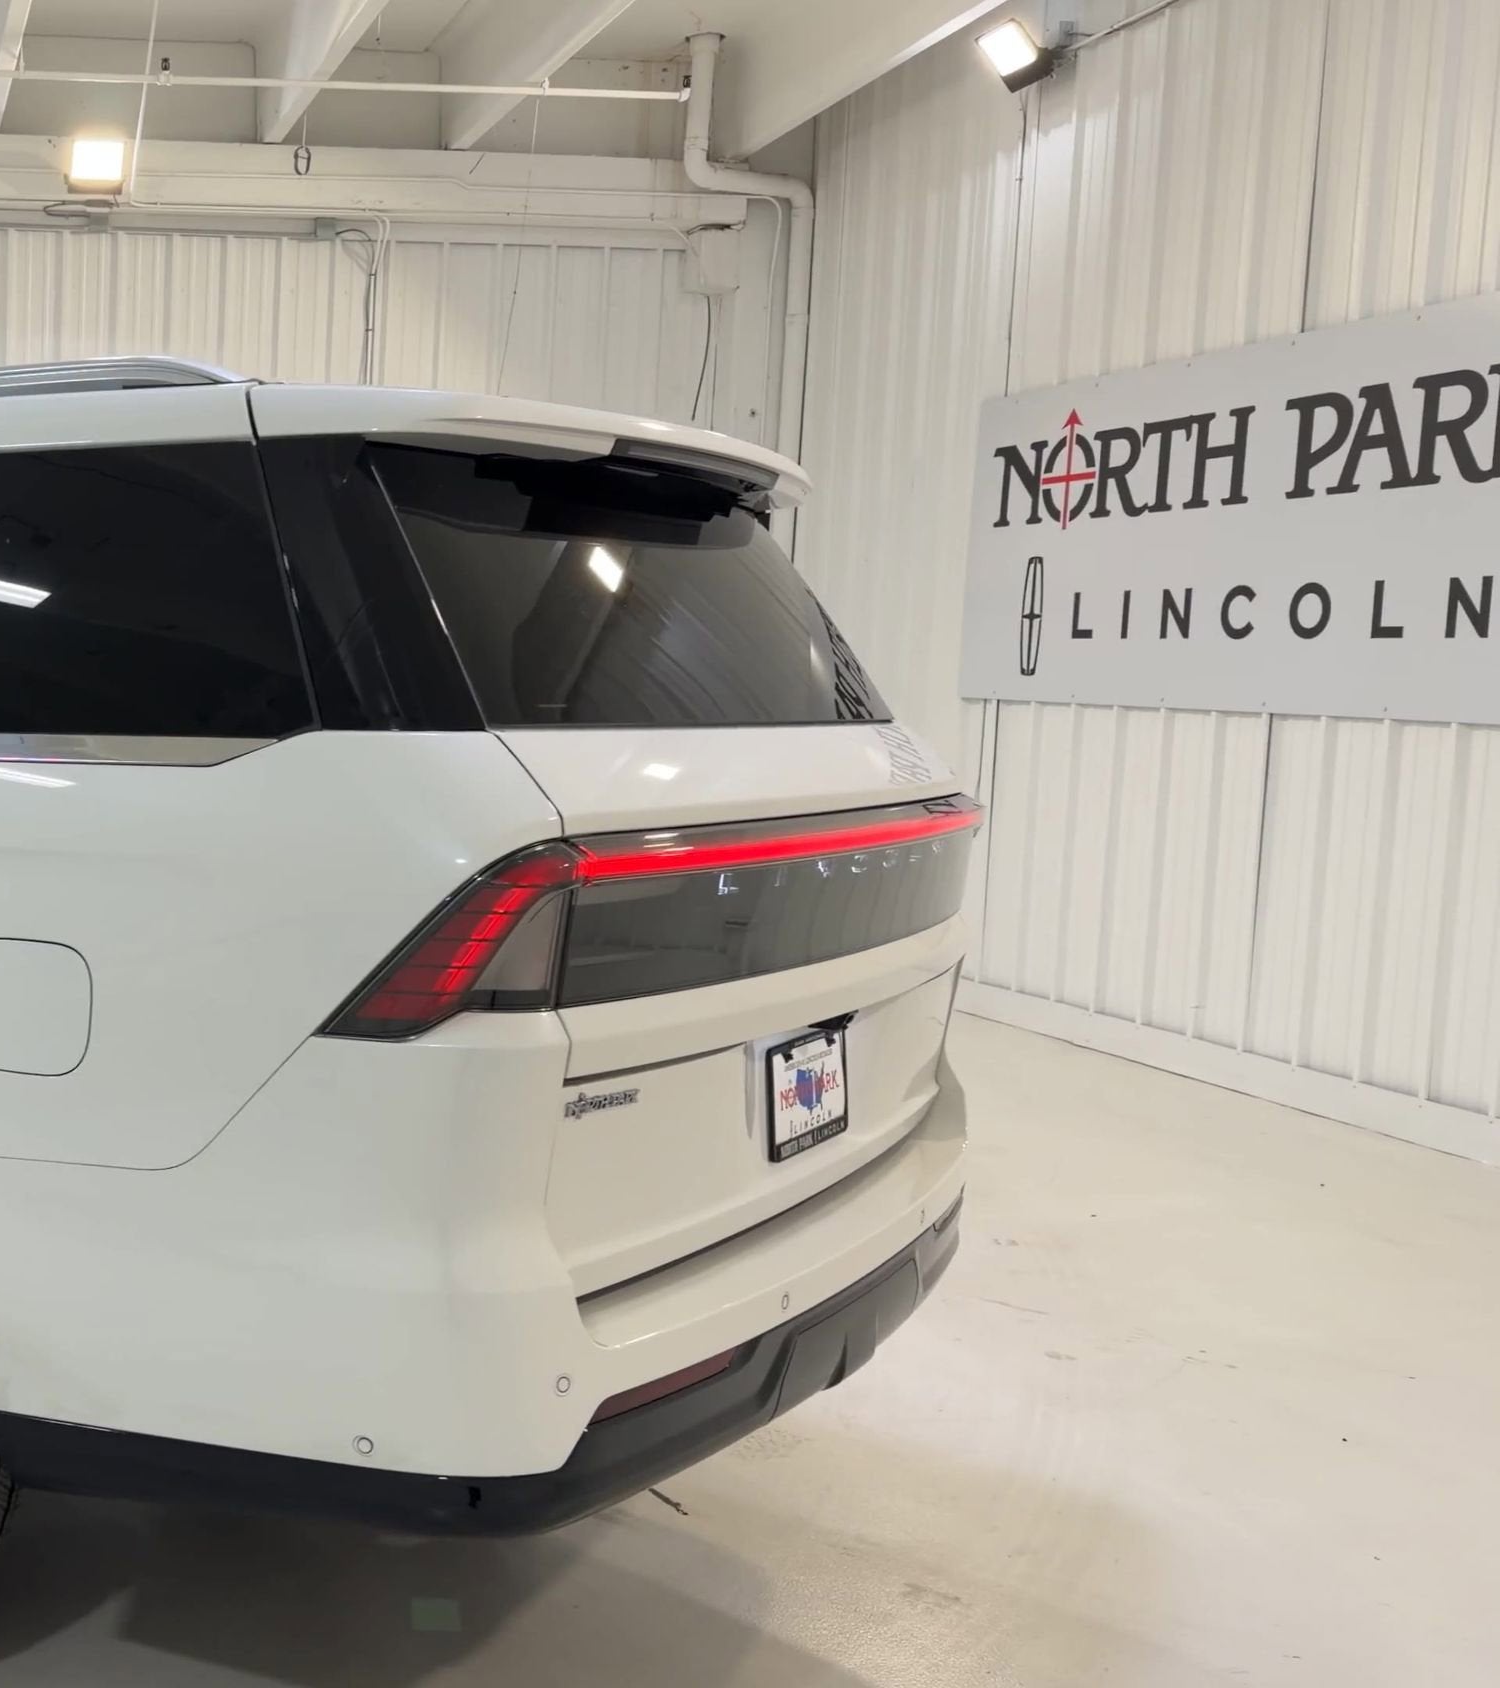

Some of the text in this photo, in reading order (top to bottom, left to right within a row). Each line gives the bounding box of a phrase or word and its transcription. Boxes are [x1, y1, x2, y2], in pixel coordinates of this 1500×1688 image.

[993, 405, 1256, 529] NORTH
[1071, 575, 1494, 640] LINCOLN
[793, 1110, 833, 1135] LINCOLN
[817, 1120, 845, 1140] LINCOLN
